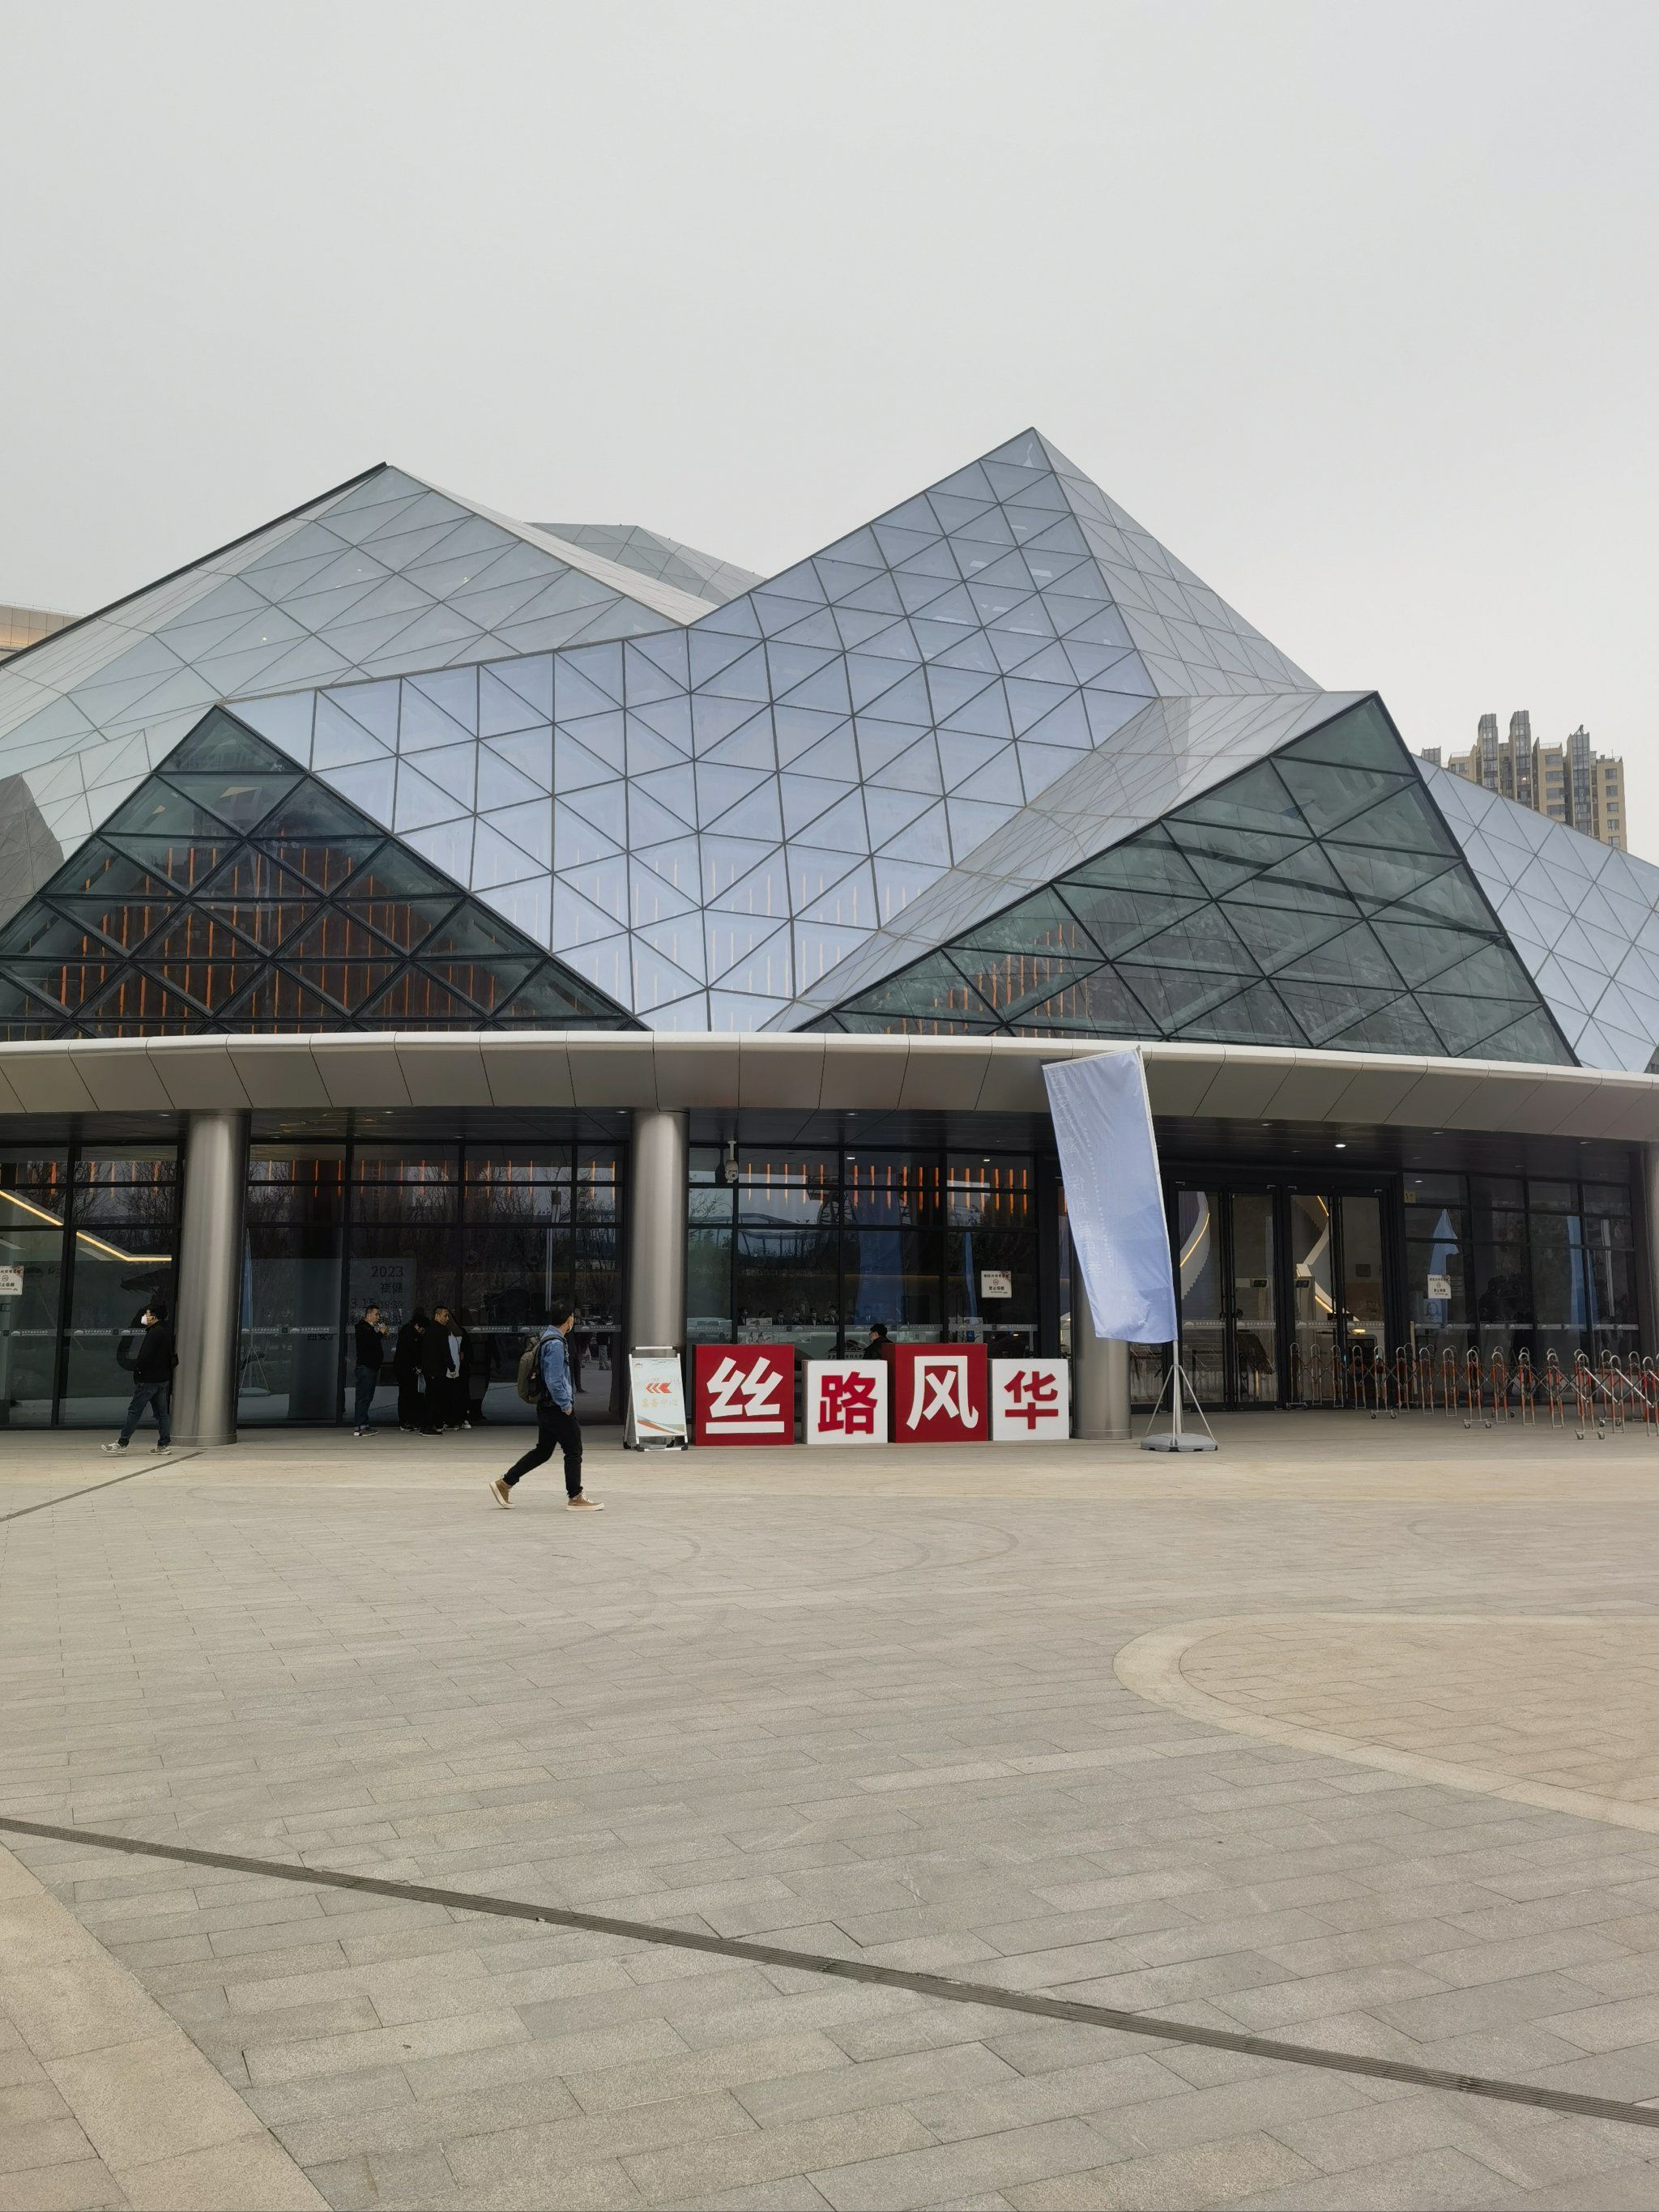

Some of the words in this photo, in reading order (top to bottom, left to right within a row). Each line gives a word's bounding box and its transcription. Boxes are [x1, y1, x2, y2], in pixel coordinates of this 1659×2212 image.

[371, 1266, 403, 1277] 2023
[705, 1355, 1060, 1435] 丝路风华
